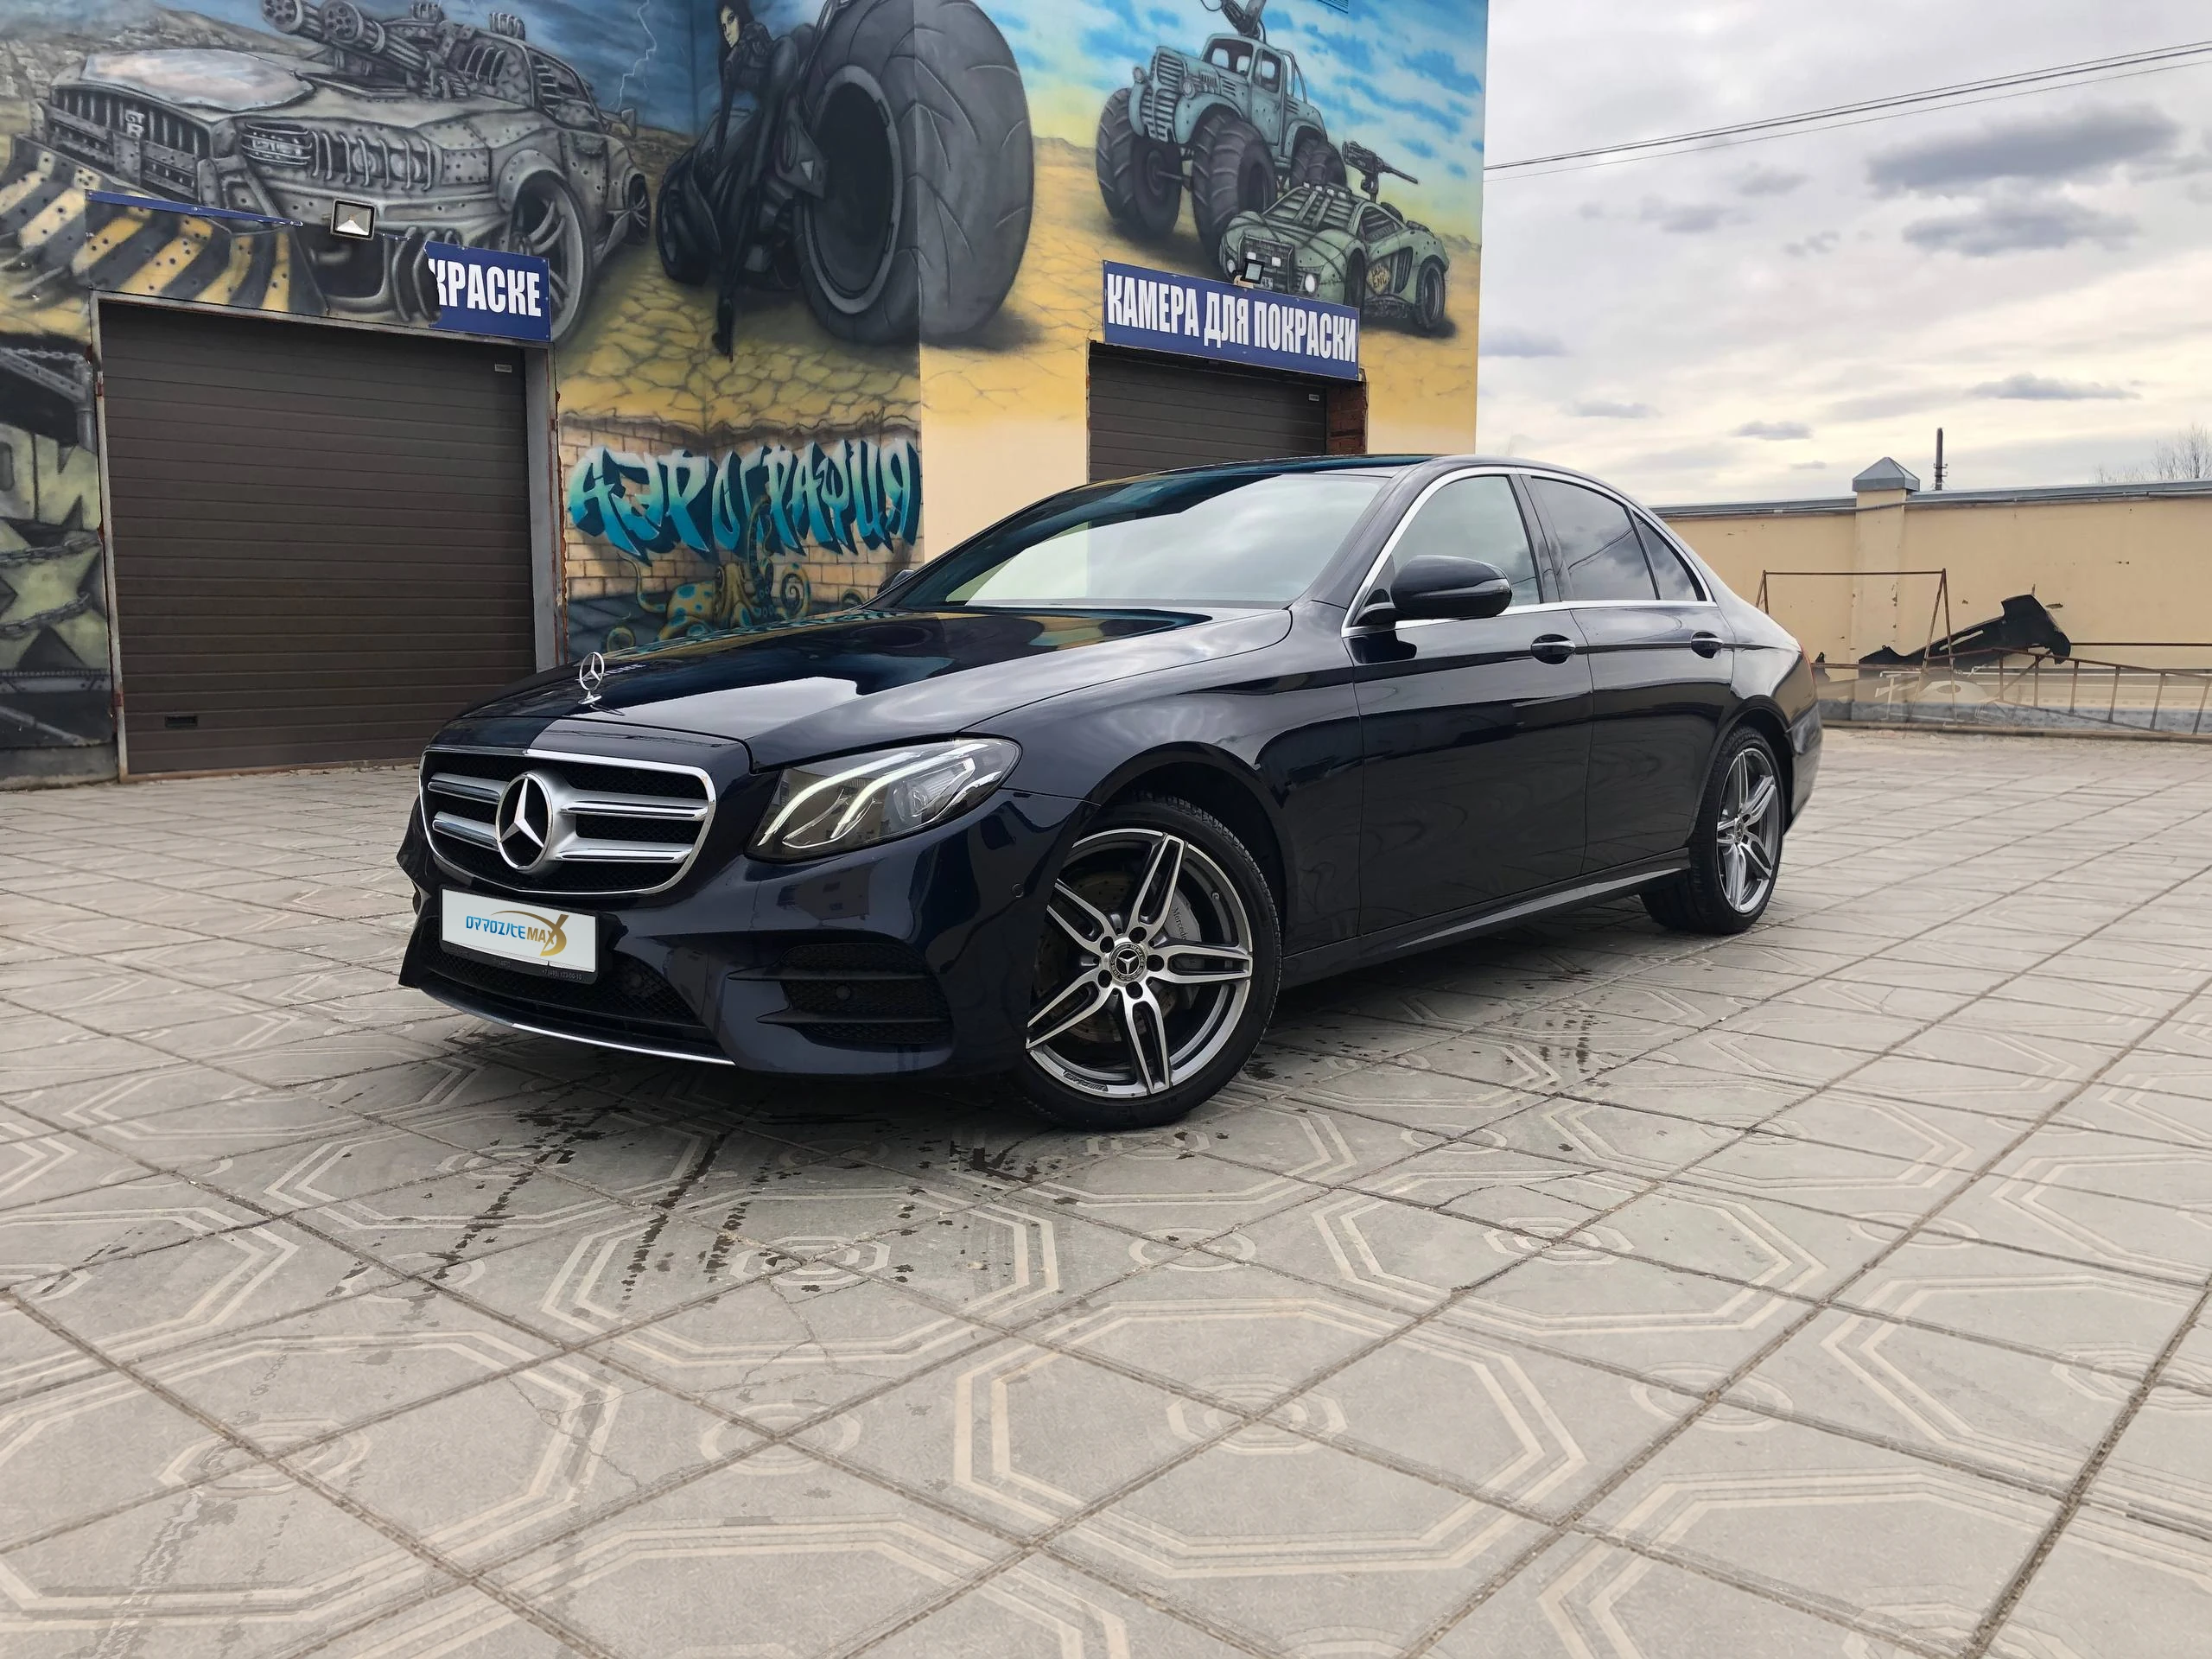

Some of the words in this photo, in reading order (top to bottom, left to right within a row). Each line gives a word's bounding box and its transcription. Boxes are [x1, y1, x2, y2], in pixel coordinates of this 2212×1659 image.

[1107, 273, 1199, 338] КАМЕРА
[1204, 291, 1249, 348] ДЛЯ
[1254, 300, 1356, 363] ПОКРАСКИ
[1173, 906, 1188, 940] Mercede
